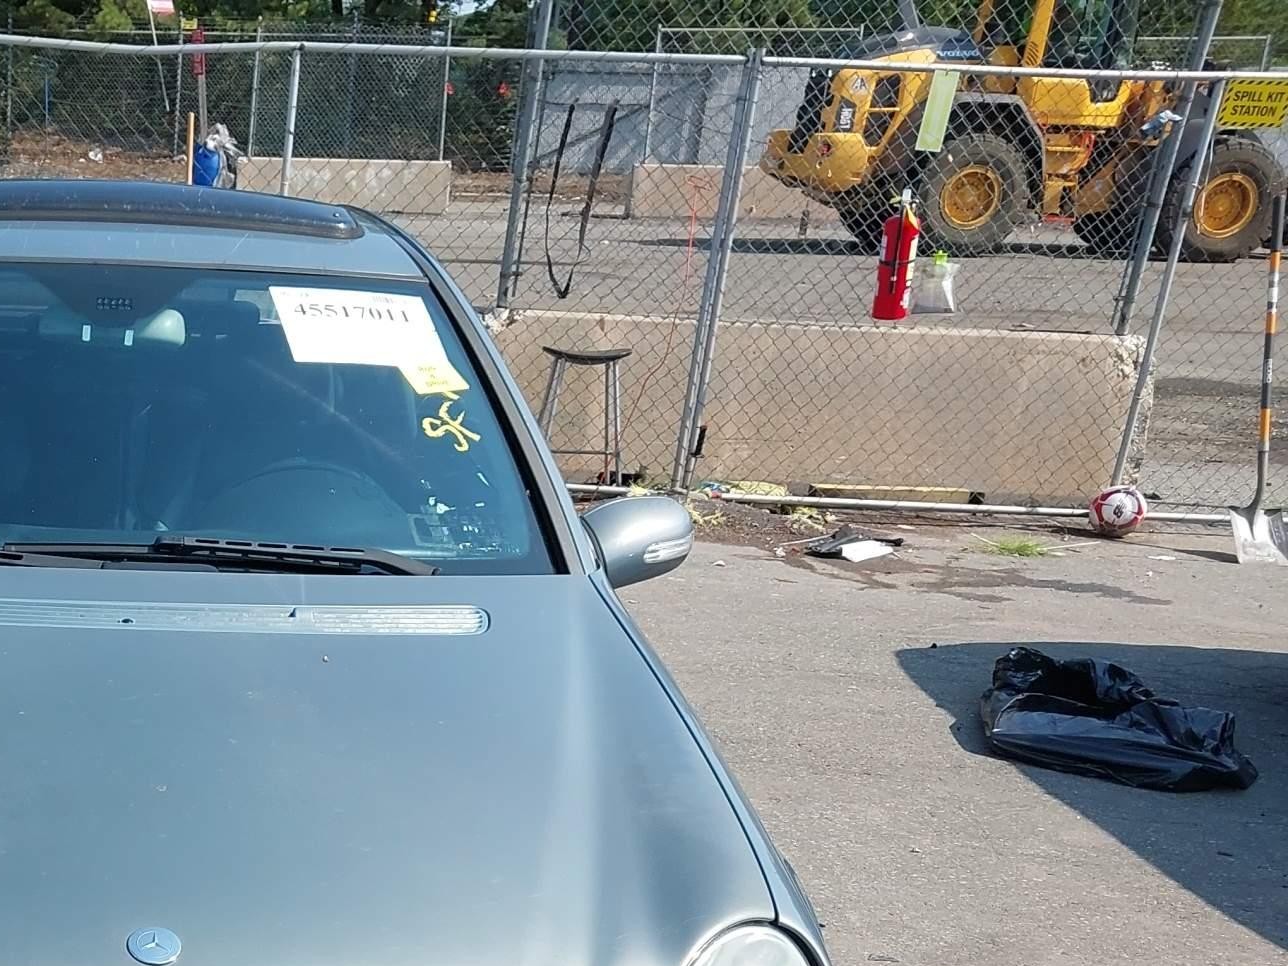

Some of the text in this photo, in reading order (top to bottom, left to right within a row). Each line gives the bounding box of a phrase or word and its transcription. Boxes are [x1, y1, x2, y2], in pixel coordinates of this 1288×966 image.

[1233, 91, 1285, 103] SPILL KIT
[1231, 105, 1276, 117] STATION
[293, 302, 410, 323] 45517011
